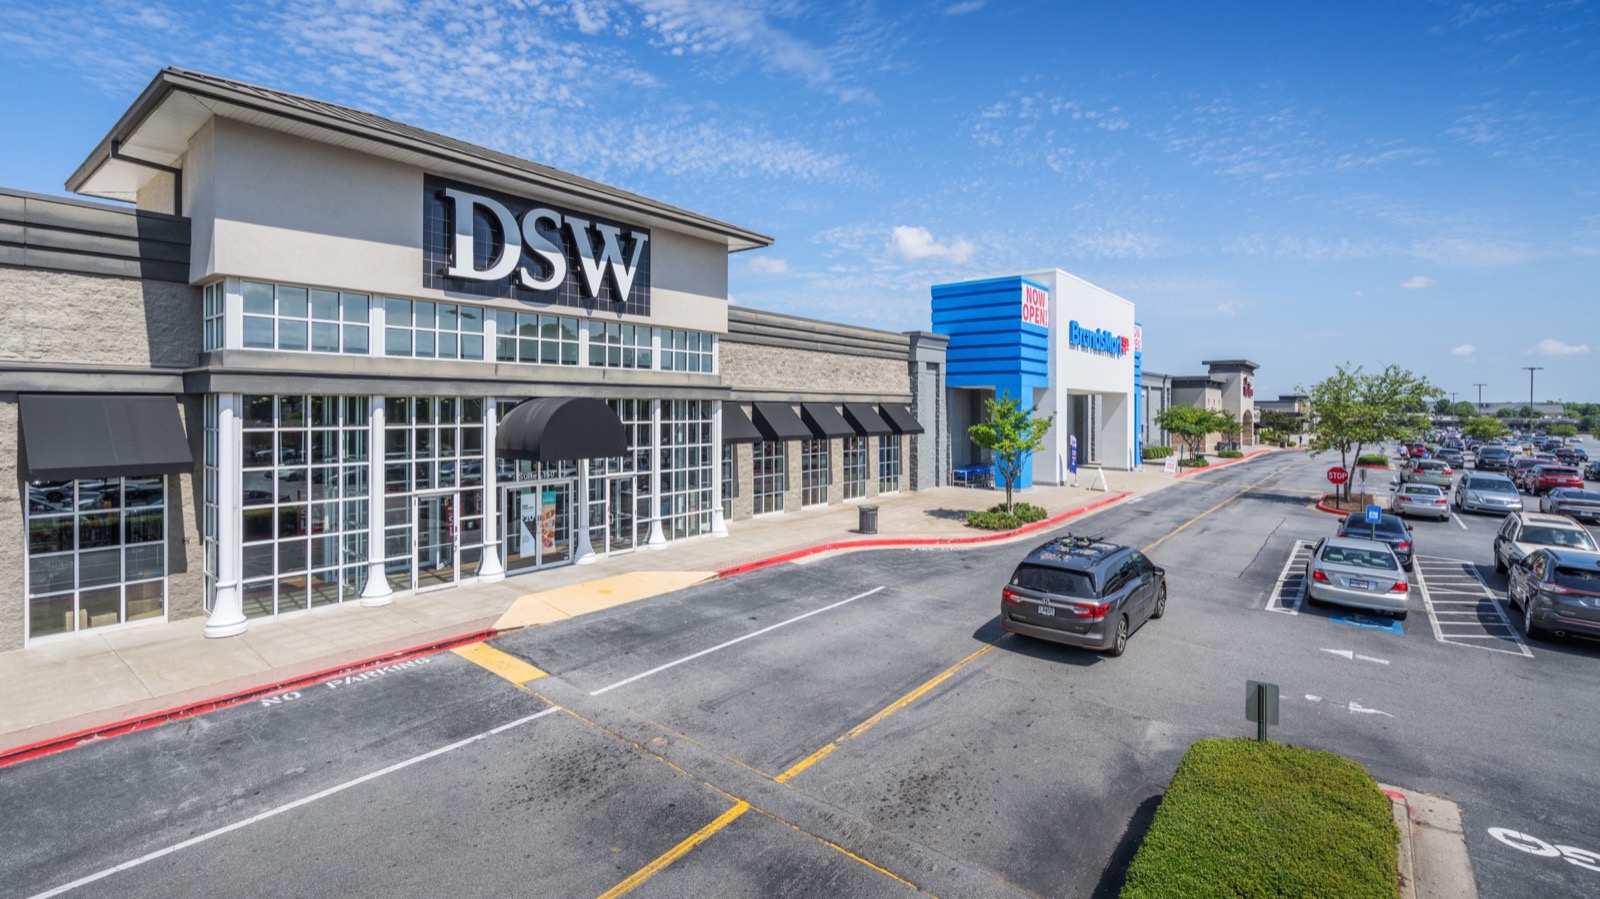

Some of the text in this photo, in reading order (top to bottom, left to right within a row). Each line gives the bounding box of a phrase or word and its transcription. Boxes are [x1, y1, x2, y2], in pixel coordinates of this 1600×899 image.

[445, 187, 649, 302] DSW
[1026, 285, 1046, 308] NOW
[1022, 303, 1048, 326] OPEN!
[1328, 471, 1348, 480] STOP
[260, 657, 431, 707] NO PARKING
